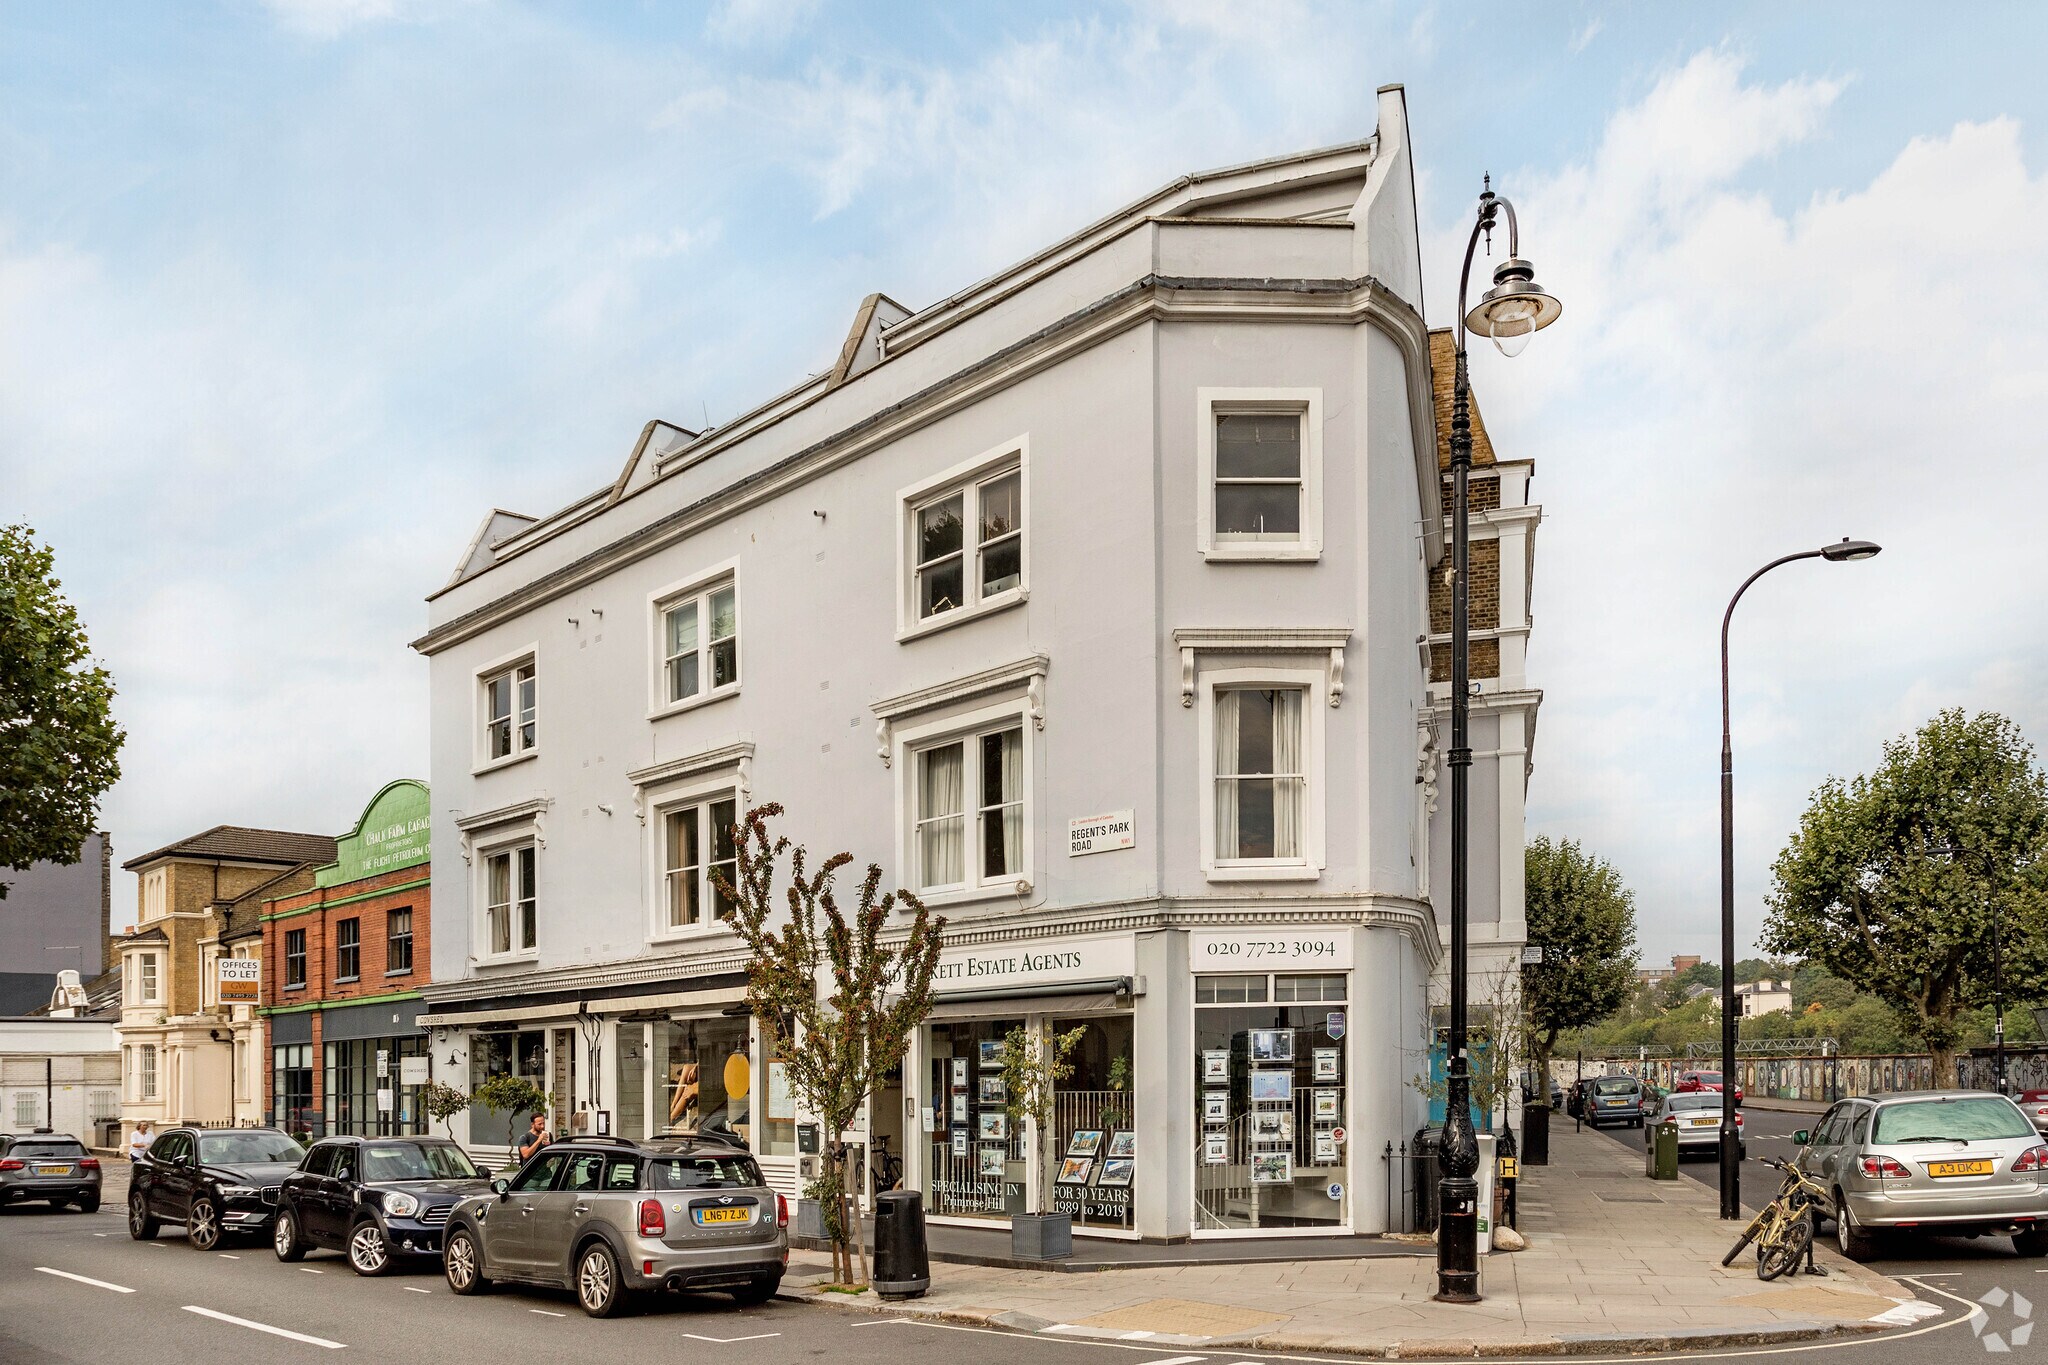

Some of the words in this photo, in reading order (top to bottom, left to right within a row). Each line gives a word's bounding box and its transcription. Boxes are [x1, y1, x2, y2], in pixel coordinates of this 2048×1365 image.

[367, 830, 386, 846] CHALK
[389, 824, 405, 839] FARM
[1072, 825, 1106, 840] REGENT'S
[1109, 822, 1129, 834] PARK
[1072, 840, 1091, 852] ROAD
[363, 860, 371, 870] THE
[374, 855, 390, 867] FLIGHT
[393, 846, 423, 862] PETROLEUM
[1207, 942, 1240, 955] 020
[1247, 942, 1286, 957] 7722
[1292, 941, 1335, 957] 3094
[967, 958, 1016, 976] ESTATE
[1021, 951, 1081, 971] AGENTS
[222, 970, 236, 978] TO
[420, 1015, 443, 1024] COWSHED
[1503, 1160, 1515, 1175] H
[1939, 1163, 1955, 1174] A3
[931, 1180, 1002, 1195] SPECIALISING
[1006, 1184, 1020, 1196] IN
[1052, 1185, 1073, 1199] FOR
[1076, 1187, 1087, 1200] 30
[1090, 1188, 1129, 1203] YEARS
[944, 1194, 984, 1209] Primrose
[987, 1197, 1005, 1211] Hill
[1055, 1201, 1079, 1214] 1989
[1083, 1205, 1093, 1215] to
[1097, 1204, 1124, 1217] 2019
[704, 1211, 727, 1221] LN67
[730, 1209, 748, 1219] ZJK
